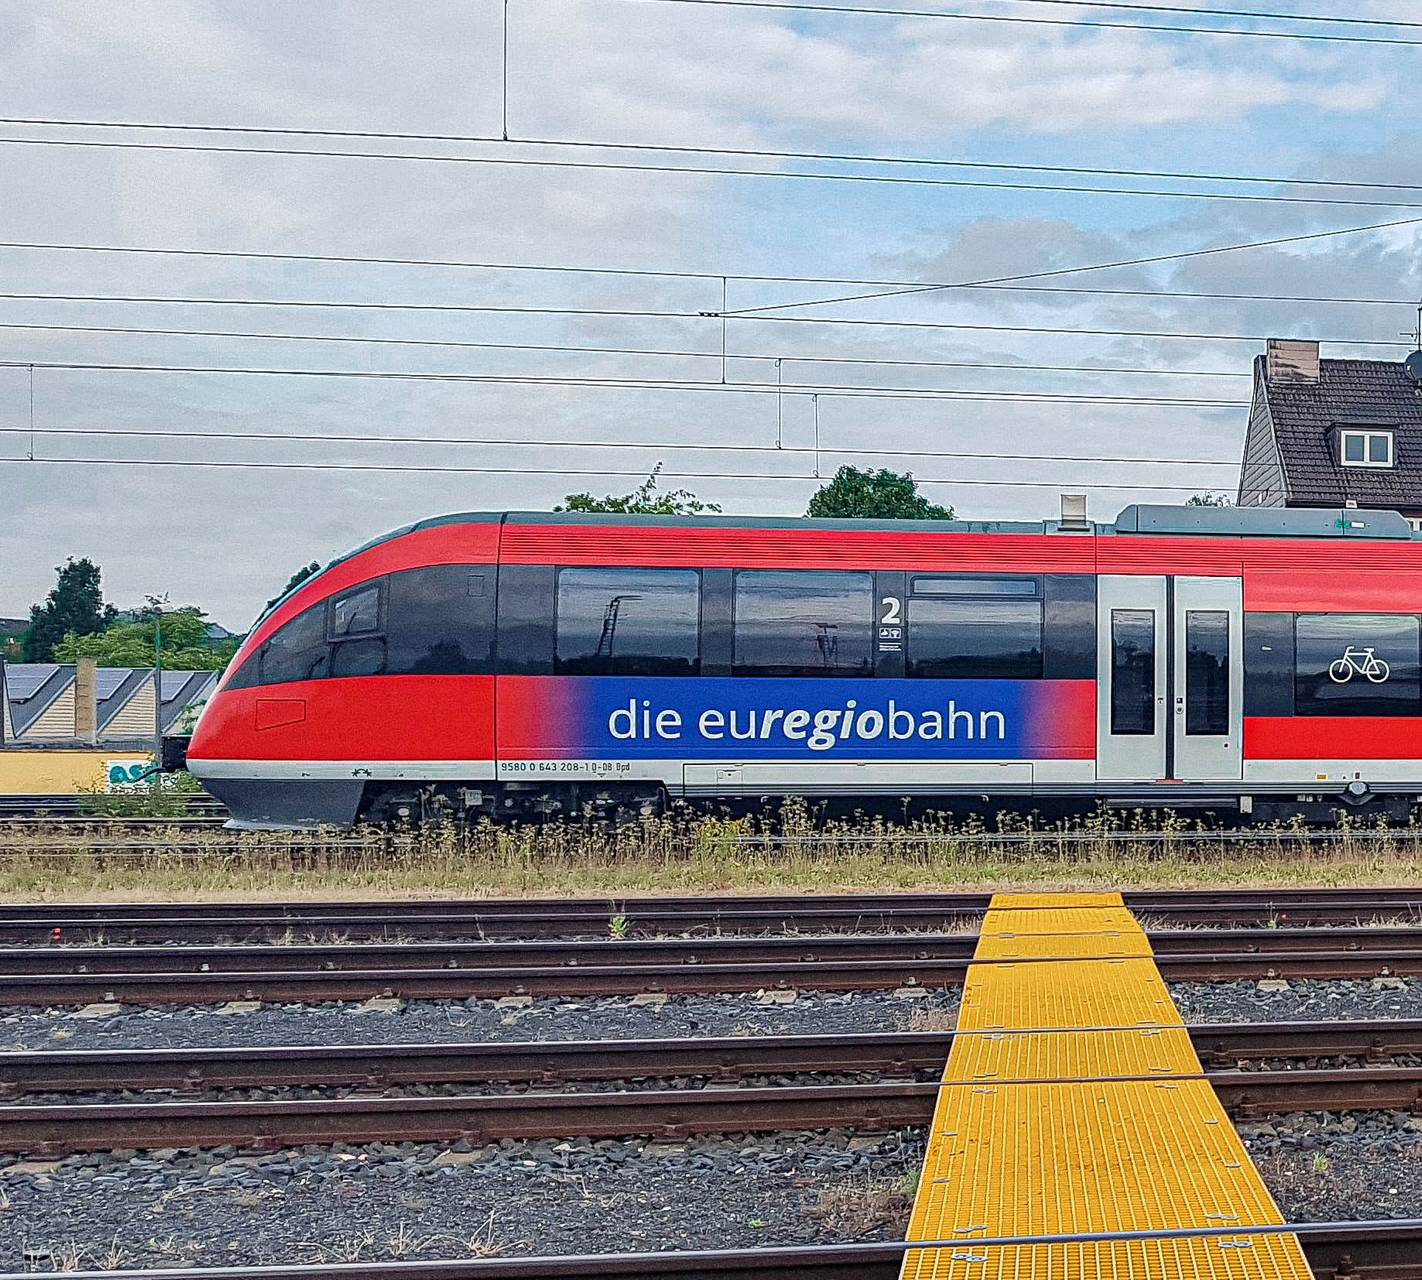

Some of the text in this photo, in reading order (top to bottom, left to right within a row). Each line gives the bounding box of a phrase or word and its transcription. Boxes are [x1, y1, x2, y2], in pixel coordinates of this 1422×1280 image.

[881, 596, 900, 624] 2
[608, 699, 1006, 750] die euregiobahn
[501, 762, 527, 771] 9580
[529, 762, 536, 771] 0
[538, 762, 557, 771] 643
[560, 762, 589, 771] 208-1
